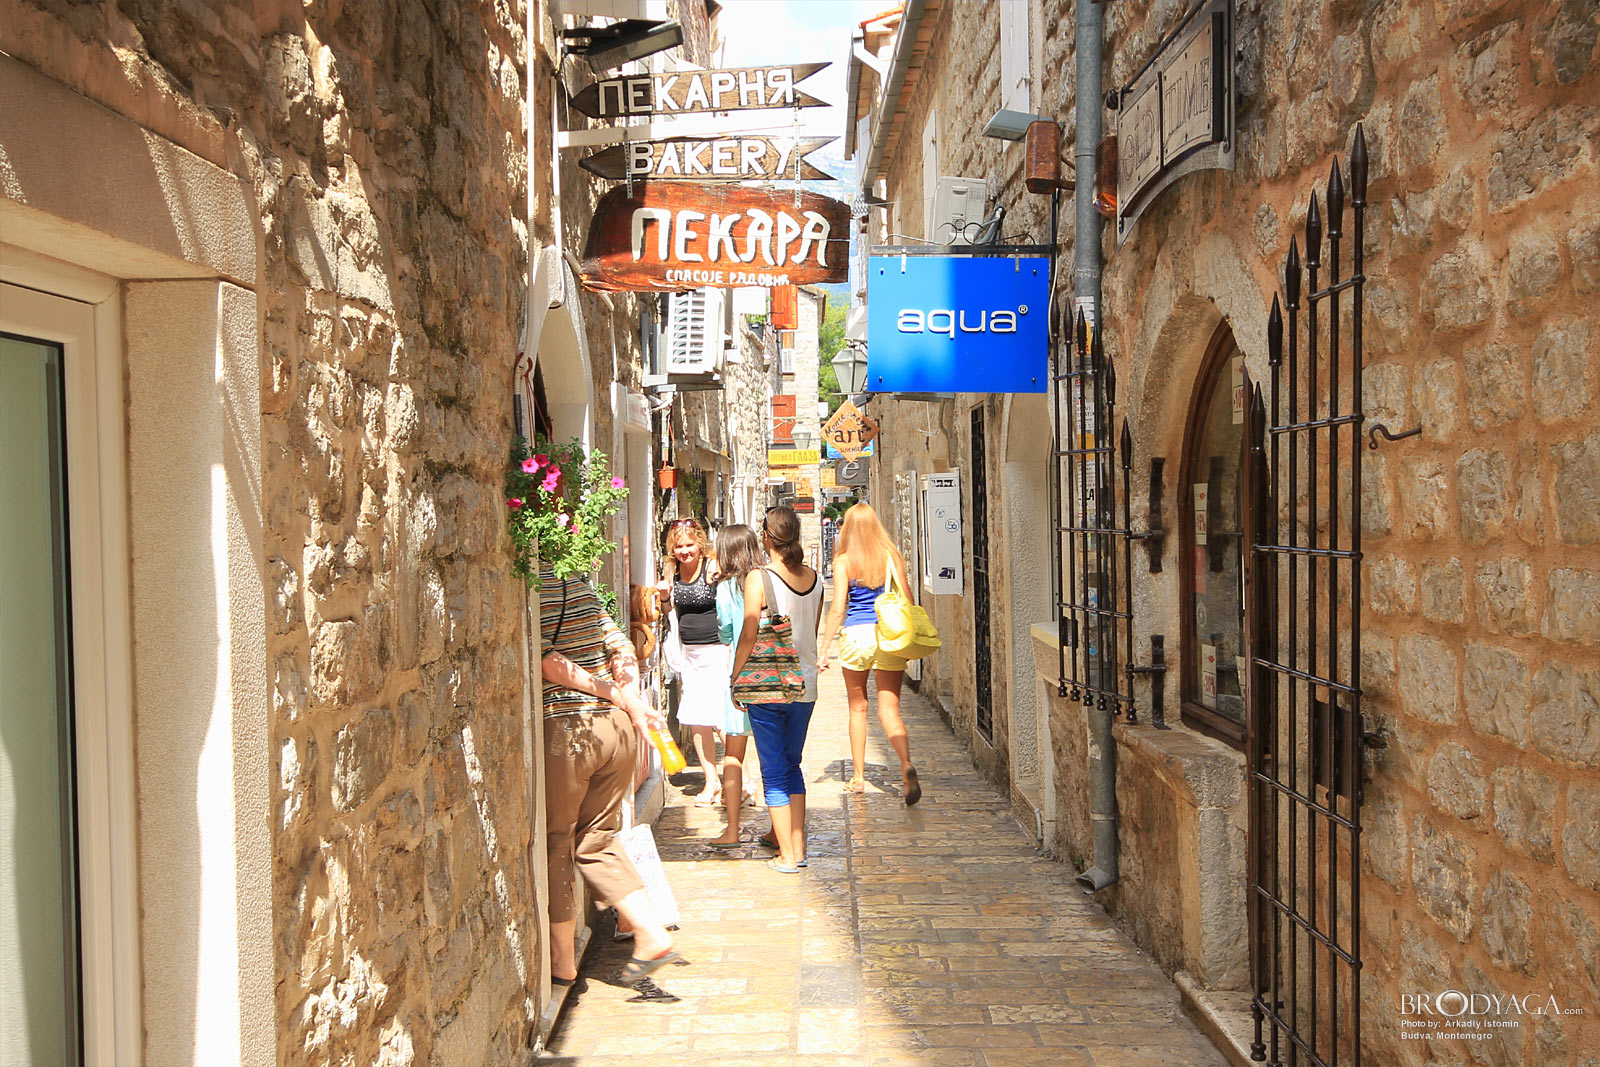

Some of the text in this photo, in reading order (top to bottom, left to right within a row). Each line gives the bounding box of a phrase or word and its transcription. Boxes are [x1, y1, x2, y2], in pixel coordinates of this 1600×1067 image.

[598, 68, 794, 115] ПЕКАРНЯ
[1165, 56, 1210, 136] TIME
[630, 139, 796, 175] BAKERY
[631, 207, 830, 268] ПЕКАРА
[834, 429, 866, 443] art
